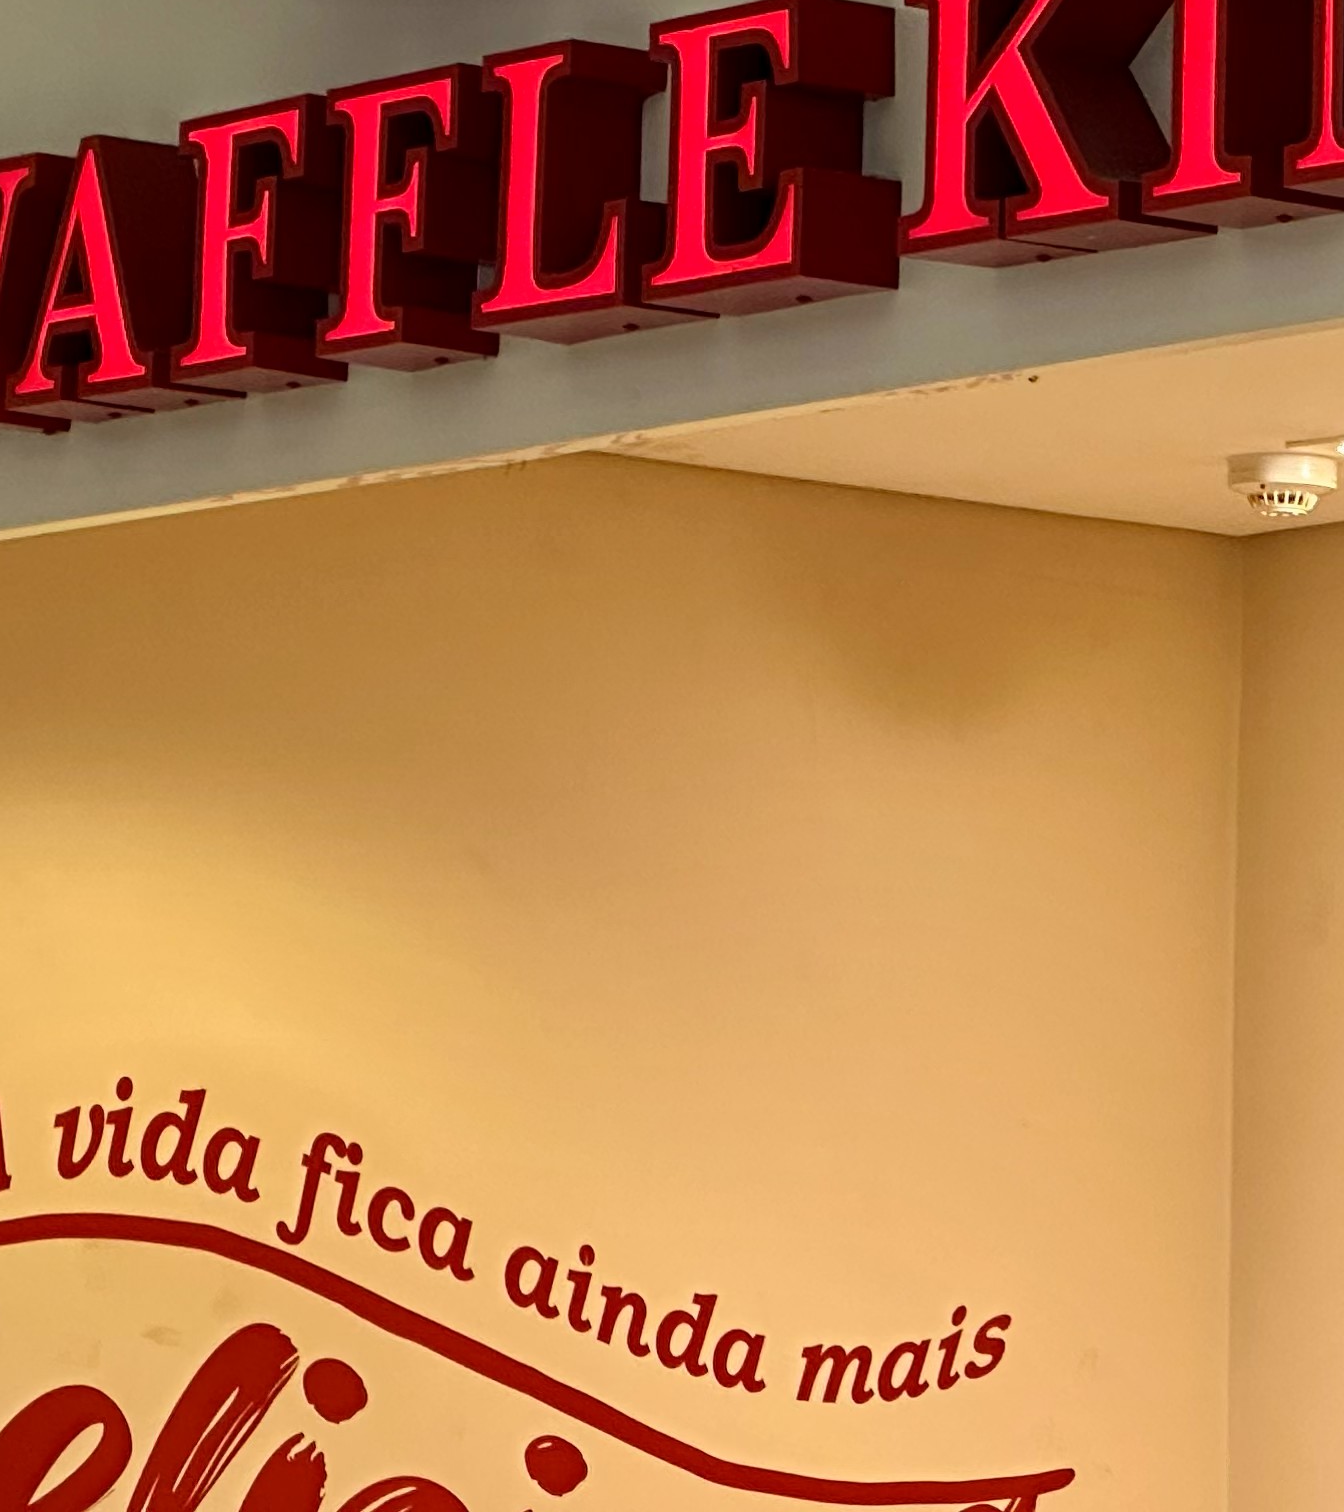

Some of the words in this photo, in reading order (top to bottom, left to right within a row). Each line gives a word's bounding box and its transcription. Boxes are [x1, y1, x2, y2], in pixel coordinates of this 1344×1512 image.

[53, 1076, 261, 1204] vida
[274, 1131, 475, 1283] fica
[503, 1243, 766, 1394] ainda
[796, 1305, 1013, 1405] mais
